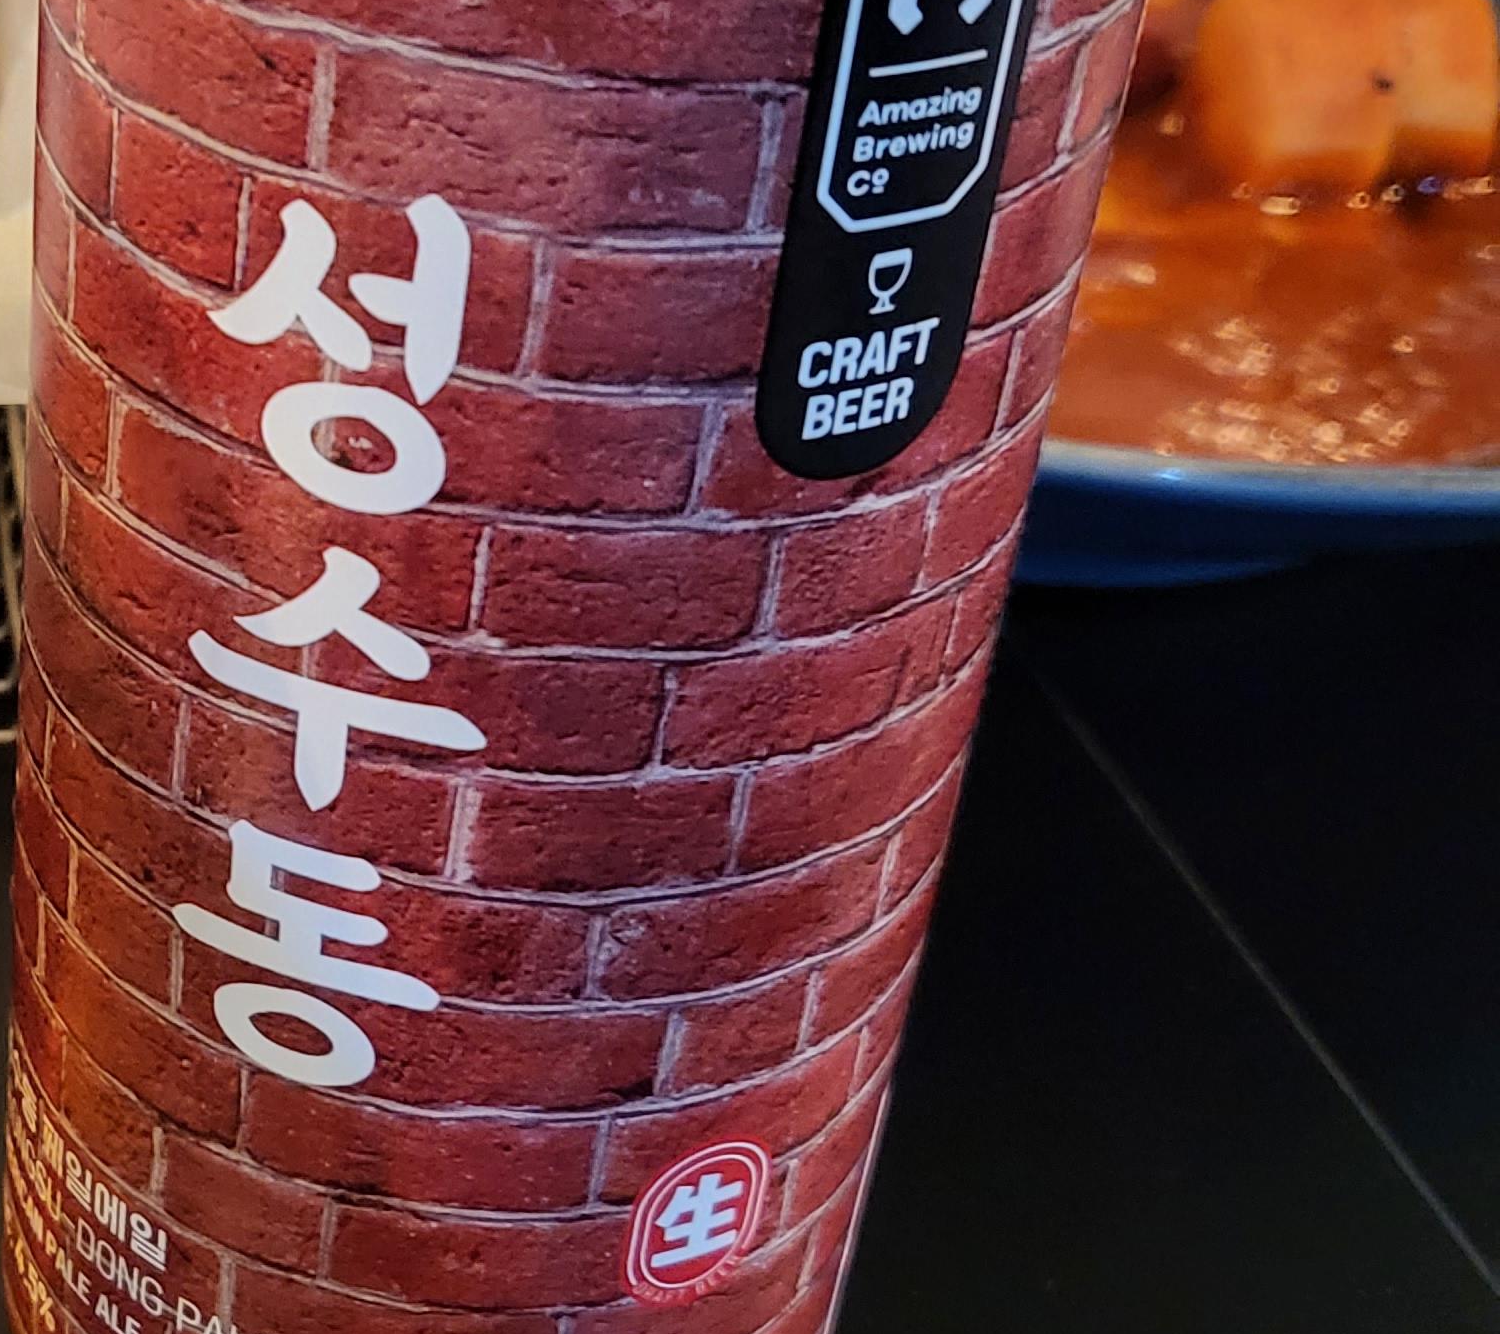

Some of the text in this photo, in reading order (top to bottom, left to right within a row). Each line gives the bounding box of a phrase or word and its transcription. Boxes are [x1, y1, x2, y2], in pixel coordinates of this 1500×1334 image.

[851, 121, 976, 163] Brewing
[857, 85, 983, 127] Amazing
[796, 316, 941, 390] CRAFT
[801, 376, 914, 441] BEER
[171, 192, 489, 1088] 성수동
[41, 1114, 167, 1272] 페일에일
[650, 1172, 745, 1268] 生
[45, 1228, 92, 1307] PALE
